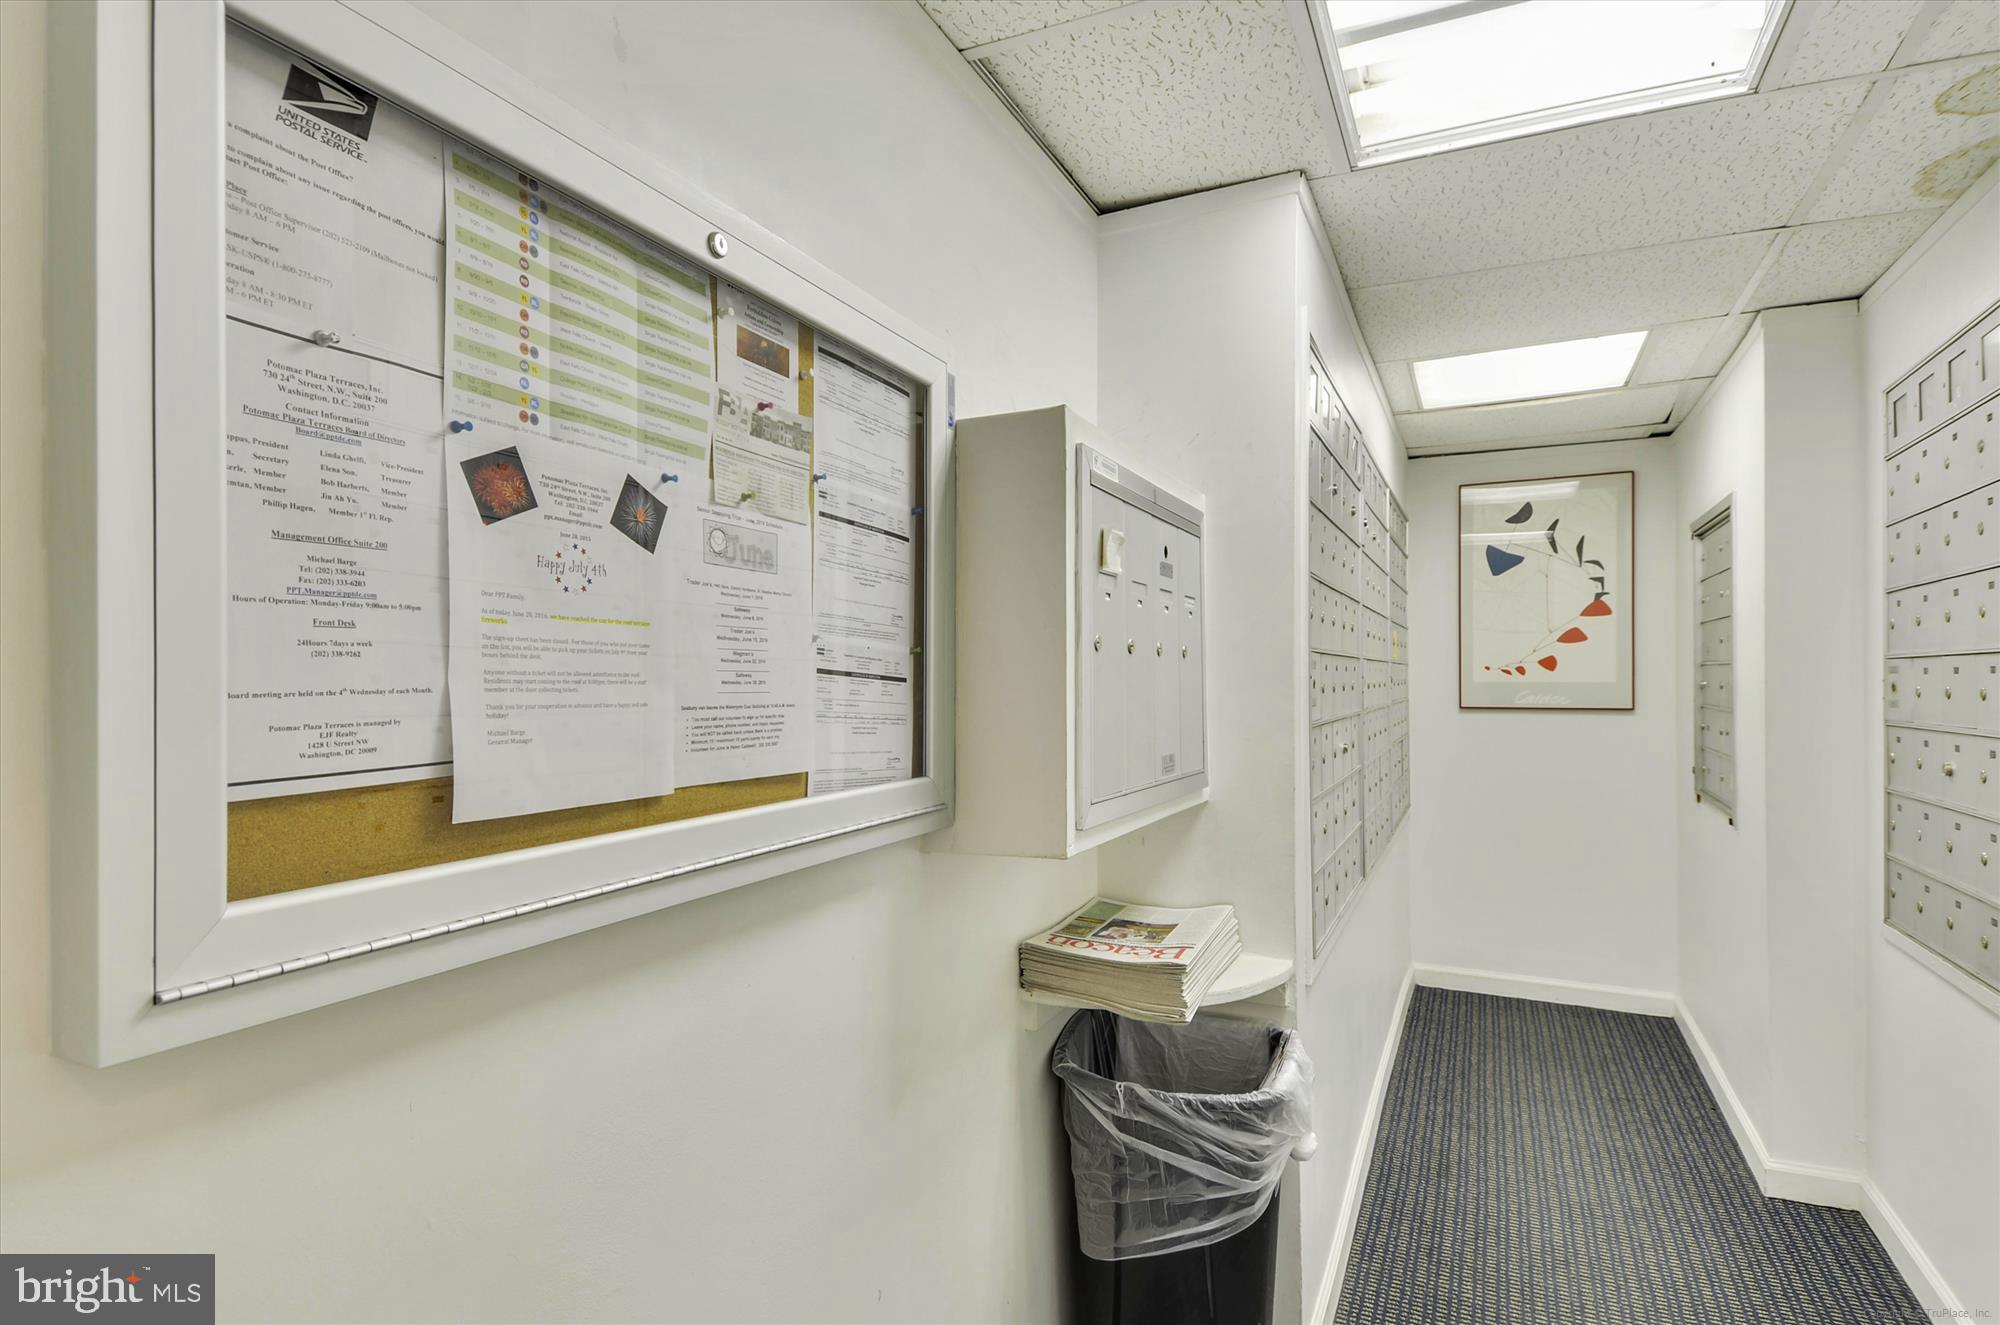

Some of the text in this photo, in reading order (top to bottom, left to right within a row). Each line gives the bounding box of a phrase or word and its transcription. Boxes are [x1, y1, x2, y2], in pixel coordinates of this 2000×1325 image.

[278, 105, 361, 151] UNITED STATES
[275, 113, 363, 161] POSTAL SERVICE
[234, 124, 354, 181] complaint about the Post Office?
[243, 160, 260, 174] Post
[236, 149, 273, 170] complain
[275, 165, 297, 180] about
[298, 175, 310, 186] any
[332, 189, 366, 210] regarding
[250, 237, 279, 252] Service
[266, 358, 384, 394] Potomac Plaza Terraces, Inc.
[262, 368, 279, 380] 730
[280, 372, 296, 383] 24th
[297, 378, 326, 391] Street,
[352, 391, 372, 402] Suite
[374, 395, 388, 405] 200
[276, 383, 376, 412] Washington, D.C. 20037
[284, 401, 370, 428] Contact Information
[242, 403, 280, 421] Potomac
[281, 412, 306, 425] Plaza
[308, 418, 344, 434] Terraces
[345, 426, 367, 438] Board
[376, 431, 406, 446] Directors
[252, 436, 290, 451] President
[252, 452, 290, 467] Secretary
[319, 449, 341, 460] Linda
[253, 466, 288, 480] Member
[320, 463, 341, 474] Elena
[381, 460, 425, 477] Vice-President
[254, 481, 288, 494] Member
[320, 477, 335, 487] Bob
[380, 474, 412, 487] Treasurer
[320, 491, 332, 501] Jin
[380, 487, 409, 499] Member
[261, 498, 317, 513] Phillip Hagen,
[380, 501, 408, 512] Member
[328, 507, 358, 519] Member
[379, 514, 394, 524] Rep.
[270, 529, 389, 551] Management Office Suite 200
[306, 554, 336, 565] Michael
[536, 554, 607, 579] Happy July 4th
[299, 564, 314, 573] Tel:
[315, 566, 334, 577] (202)
[298, 575, 335, 587] Fax: (202)
[232, 594, 258, 604] Hours
[259, 595, 267, 603] of
[268, 596, 309, 606] Operation:
[310, 599, 365, 610] Monday-Friday
[312, 617, 358, 630] Front Desk
[296, 639, 374, 650] 24Hours 7days week
[310, 649, 362, 660] (202) 338-9262
[251, 688, 283, 700] meeting
[284, 690, 296, 698] are
[297, 687, 314, 698] held
[326, 687, 337, 697] the
[348, 686, 387, 697] Wednesday
[396, 686, 411, 695] each
[269, 724, 302, 733] Potomac
[303, 722, 323, 732] Plaza
[324, 720, 355, 730] Terraces
[363, 718, 392, 728] managed
[393, 718, 402, 727] by
[319, 730, 358, 740] EJF Realty
[307, 737, 369, 750] 1428 Street NW
[298, 747, 345, 760] Washington,
[345, 746, 356, 755] DC
[1046, 936, 1187, 960] Beacon
